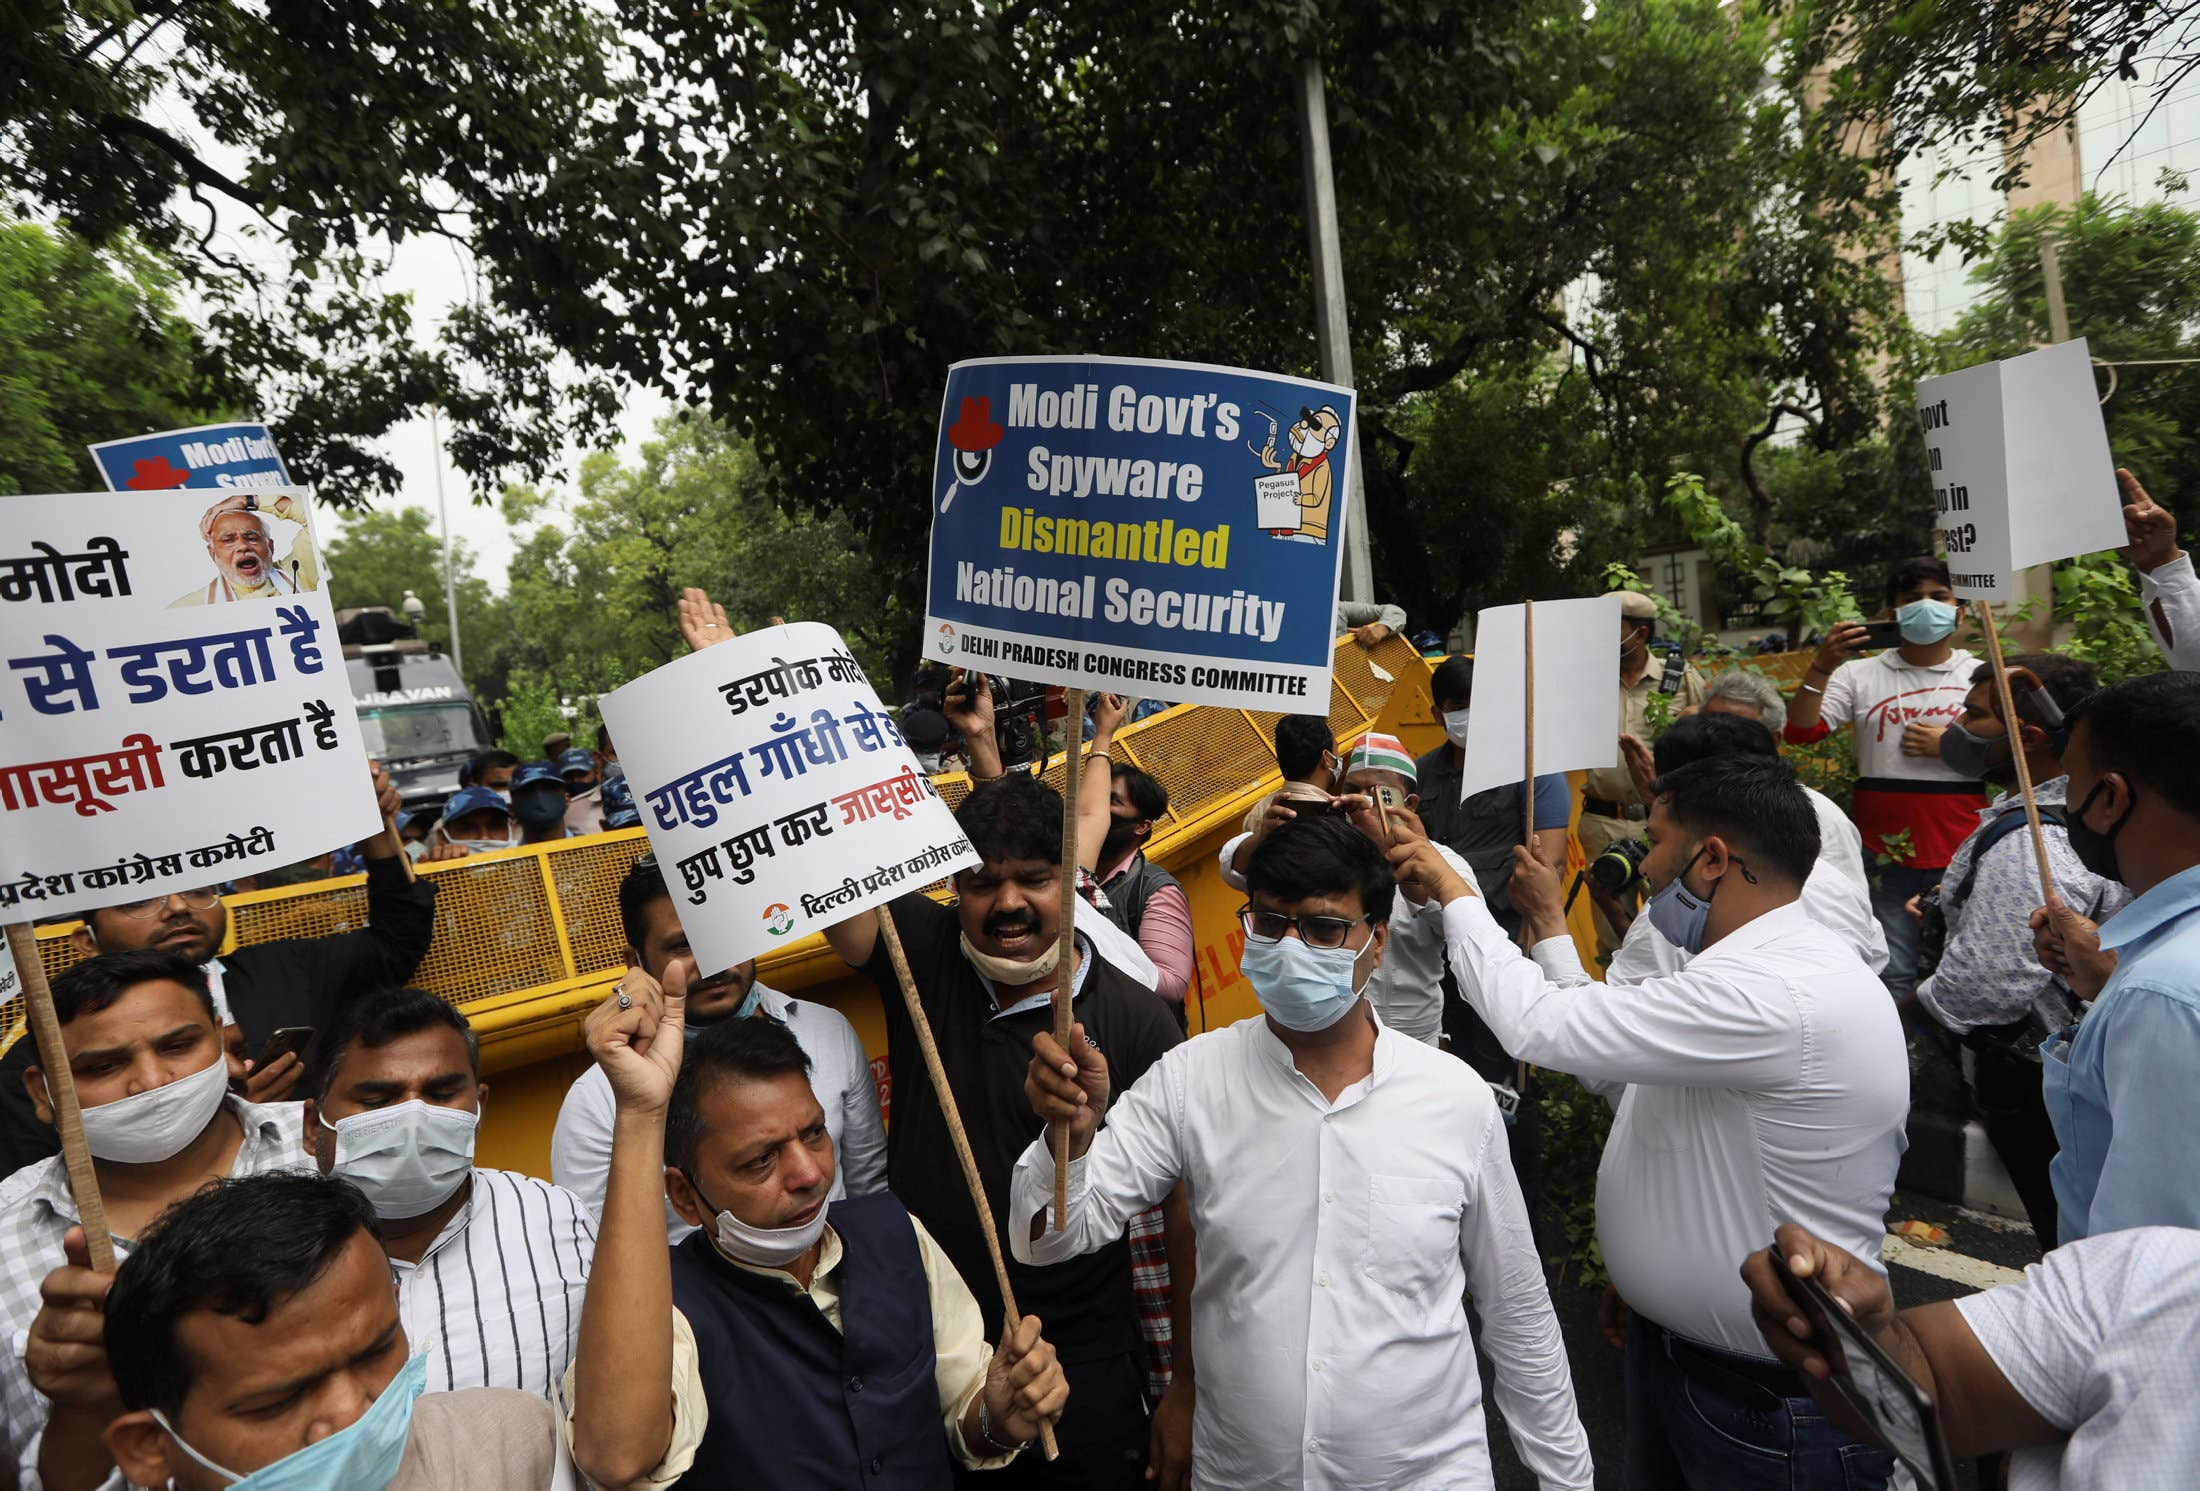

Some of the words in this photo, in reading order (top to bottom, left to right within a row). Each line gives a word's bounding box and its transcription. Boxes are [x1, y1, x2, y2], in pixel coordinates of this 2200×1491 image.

[1008, 383, 1099, 430] Modi
[1108, 385, 1240, 441] Govt's
[180, 436, 249, 469] Modi
[1027, 446, 1203, 503] Spyware
[1259, 480, 1295, 490] Pegasus
[1949, 483, 1969, 511] in
[0, 536, 132, 603] मोदी
[1000, 506, 1230, 570] Dismantled
[957, 561, 1096, 619] National
[1104, 577, 1285, 642] Security
[8, 634, 100, 715] से
[107, 626, 278, 704] डरता
[275, 604, 325, 676] है
[718, 657, 823, 715] डरपोक
[961, 633, 998, 658] DELHI
[1002, 641, 1078, 671] PRADESH
[1084, 653, 1186, 685] CONGRESS
[1191, 667, 1307, 697] COMMITTEE
[171, 717, 304, 780] करता
[303, 699, 339, 751] है
[645, 751, 752, 831] राहुल
[750, 709, 848, 781] गाँधी
[844, 701, 886, 753] से
[78, 852, 183, 890] कांग्रेस
[185, 825, 277, 869] कमेटी
[676, 845, 724, 906] छुप
[720, 824, 775, 885] छुप
[773, 801, 834, 846] कर
[830, 764, 925, 826] जासूसी
[801, 876, 862, 919] दिल्ली
[862, 863, 905, 896] प्रदेश
[904, 841, 951, 876] कांग्रेस
